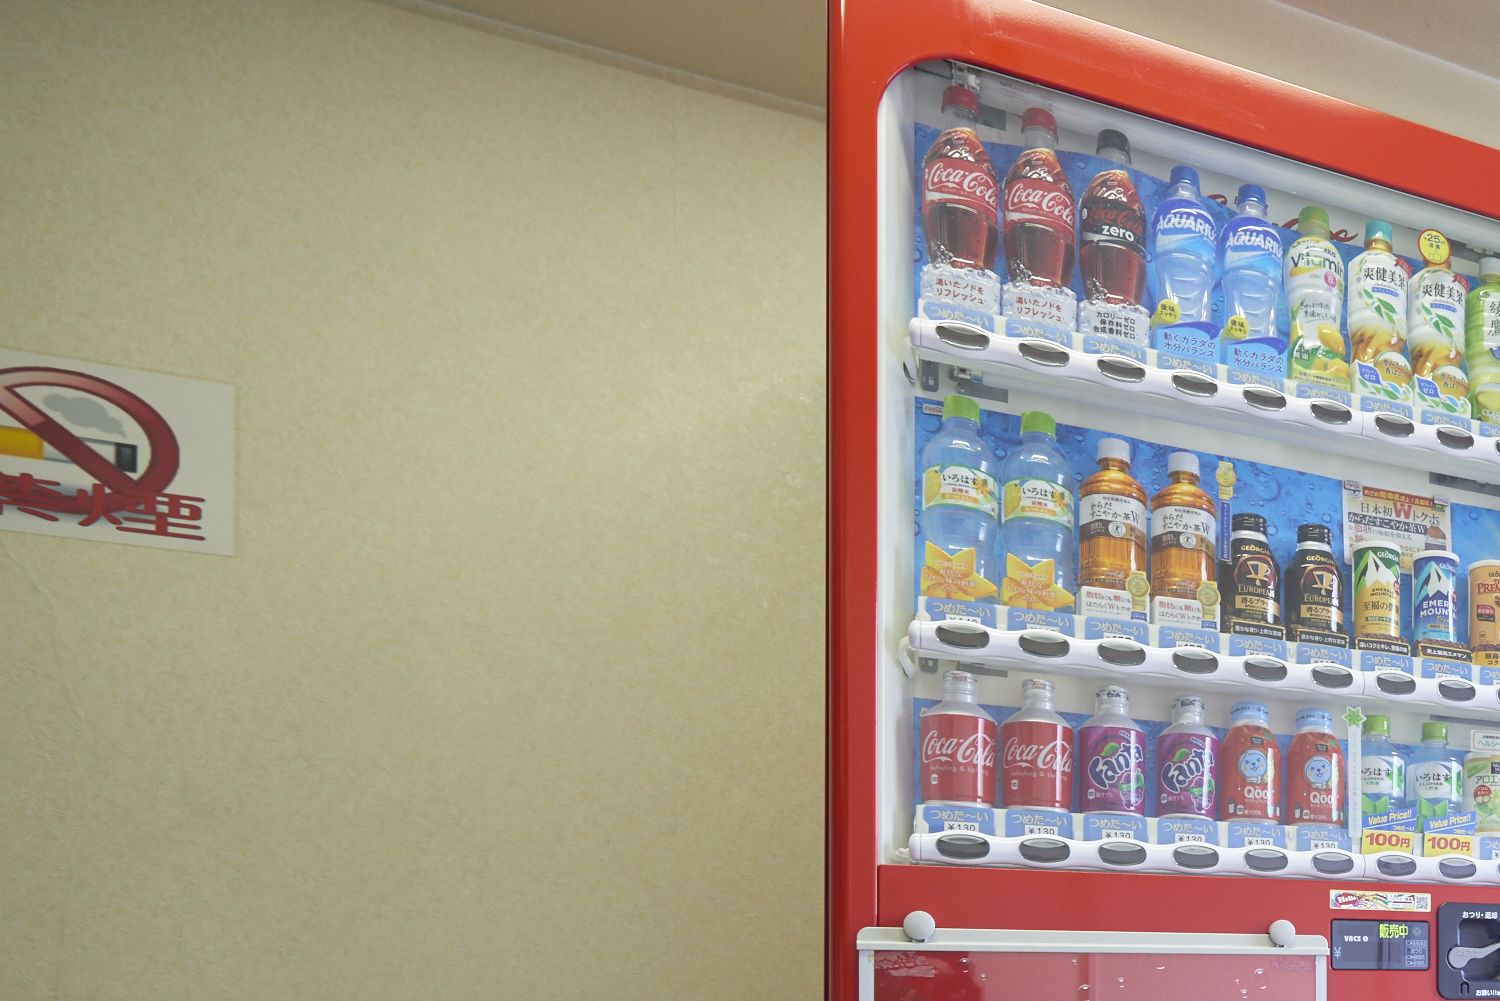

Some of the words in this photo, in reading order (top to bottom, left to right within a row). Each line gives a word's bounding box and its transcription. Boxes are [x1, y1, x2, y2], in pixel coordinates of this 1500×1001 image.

[928, 162, 997, 208] Coca-Cola
[1008, 183, 1074, 226] Coca-Cola
[1102, 223, 1135, 242] zero
[936, 288, 984, 304] リフレッシュ
[1015, 306, 1063, 322] リフレッシュ
[1348, 513, 1427, 533] からだすこやか茶W
[922, 730, 995, 768] Coca-Cola
[1003, 736, 1073, 774] Coca-Cola
[1088, 743, 1143, 790] Fanta
[1415, 773, 1451, 782] いろはす
[1244, 786, 1274, 800] Qoo
[1310, 791, 1339, 804] Qoo
[1368, 814, 1388, 825] Value
[1388, 810, 1412, 821] Price!!
[1429, 818, 1448, 829] Value
[1449, 813, 1472, 825] Price!!
[948, 823, 976, 832] ¥130
[1028, 827, 1055, 835] ¥130
[1365, 832, 1411, 848] 100円
[1427, 836, 1471, 851] 100円
[1462, 911, 1498, 919] おつり・返却
[1379, 923, 1409, 939] 販売中
[1333, 946, 1342, 959] ¥
